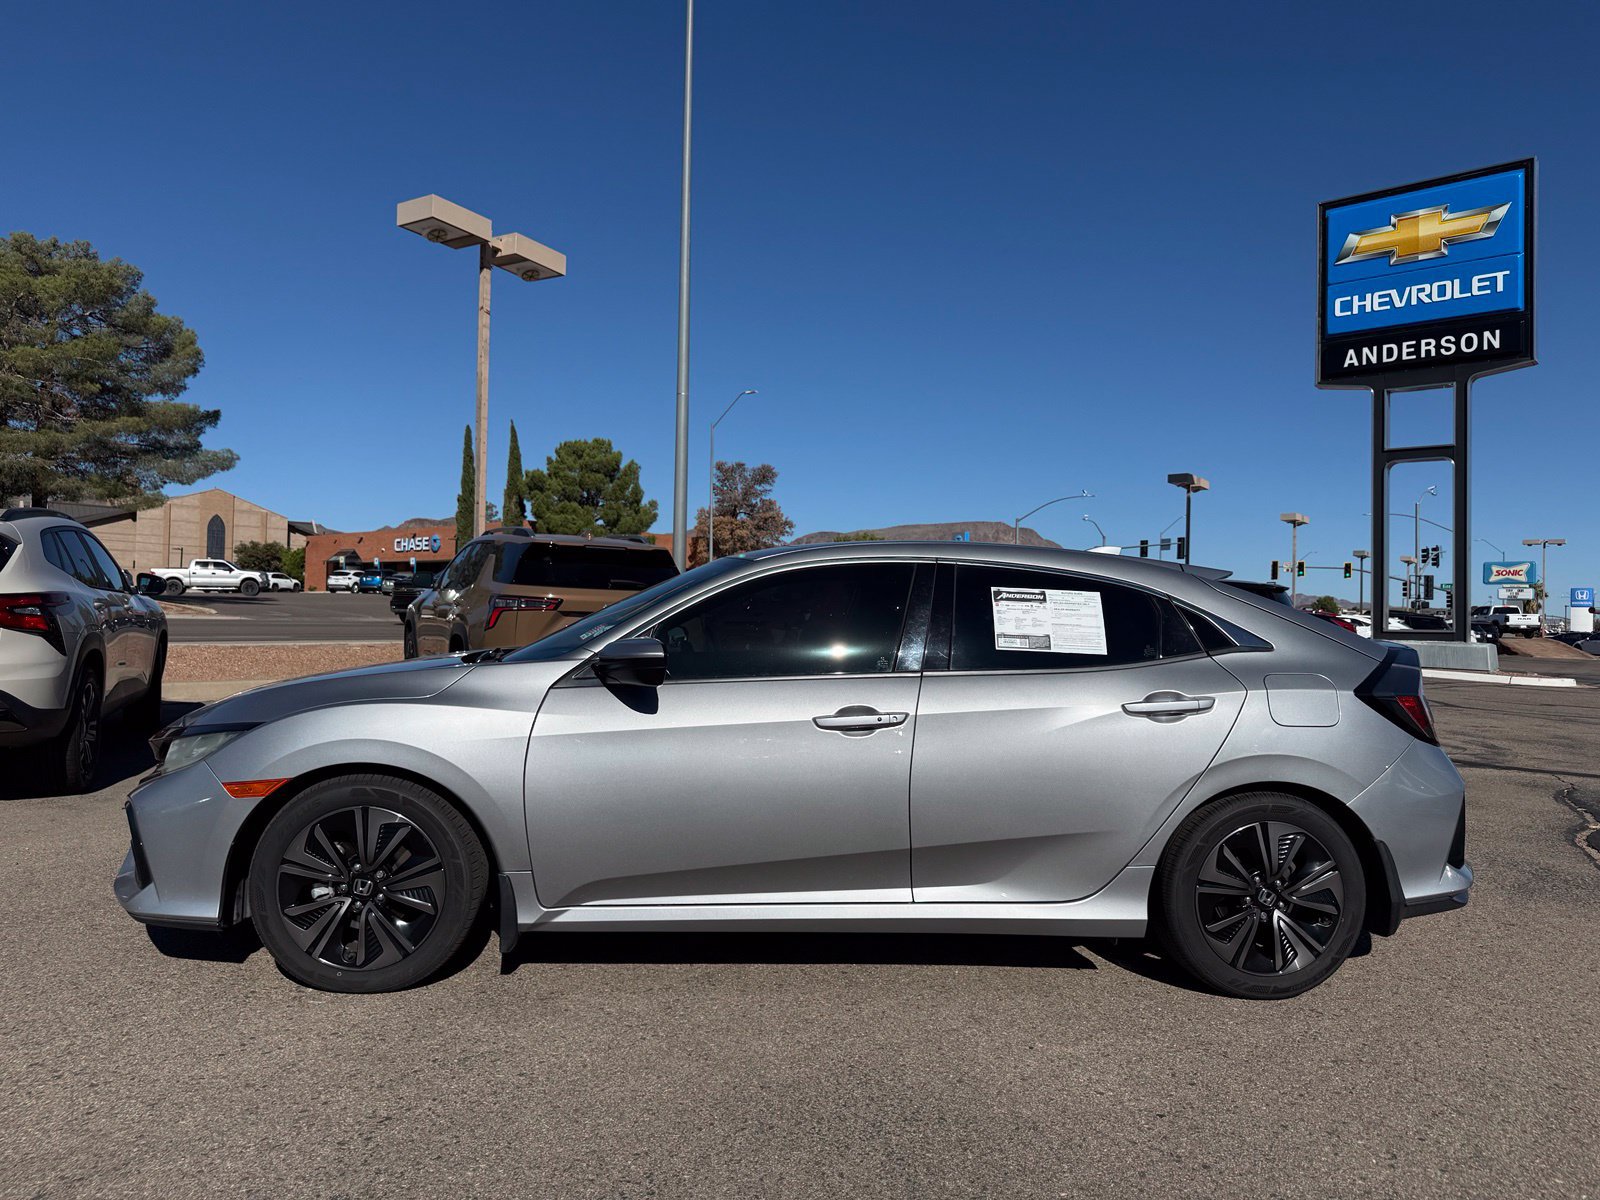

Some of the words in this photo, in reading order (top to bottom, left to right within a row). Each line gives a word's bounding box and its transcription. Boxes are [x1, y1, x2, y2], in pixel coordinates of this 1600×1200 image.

[1334, 270, 1510, 317] CHEVROLET
[1343, 329, 1501, 368] ANDERSON
[394, 536, 430, 551] CHASE
[1494, 569, 1524, 577] SONIC
